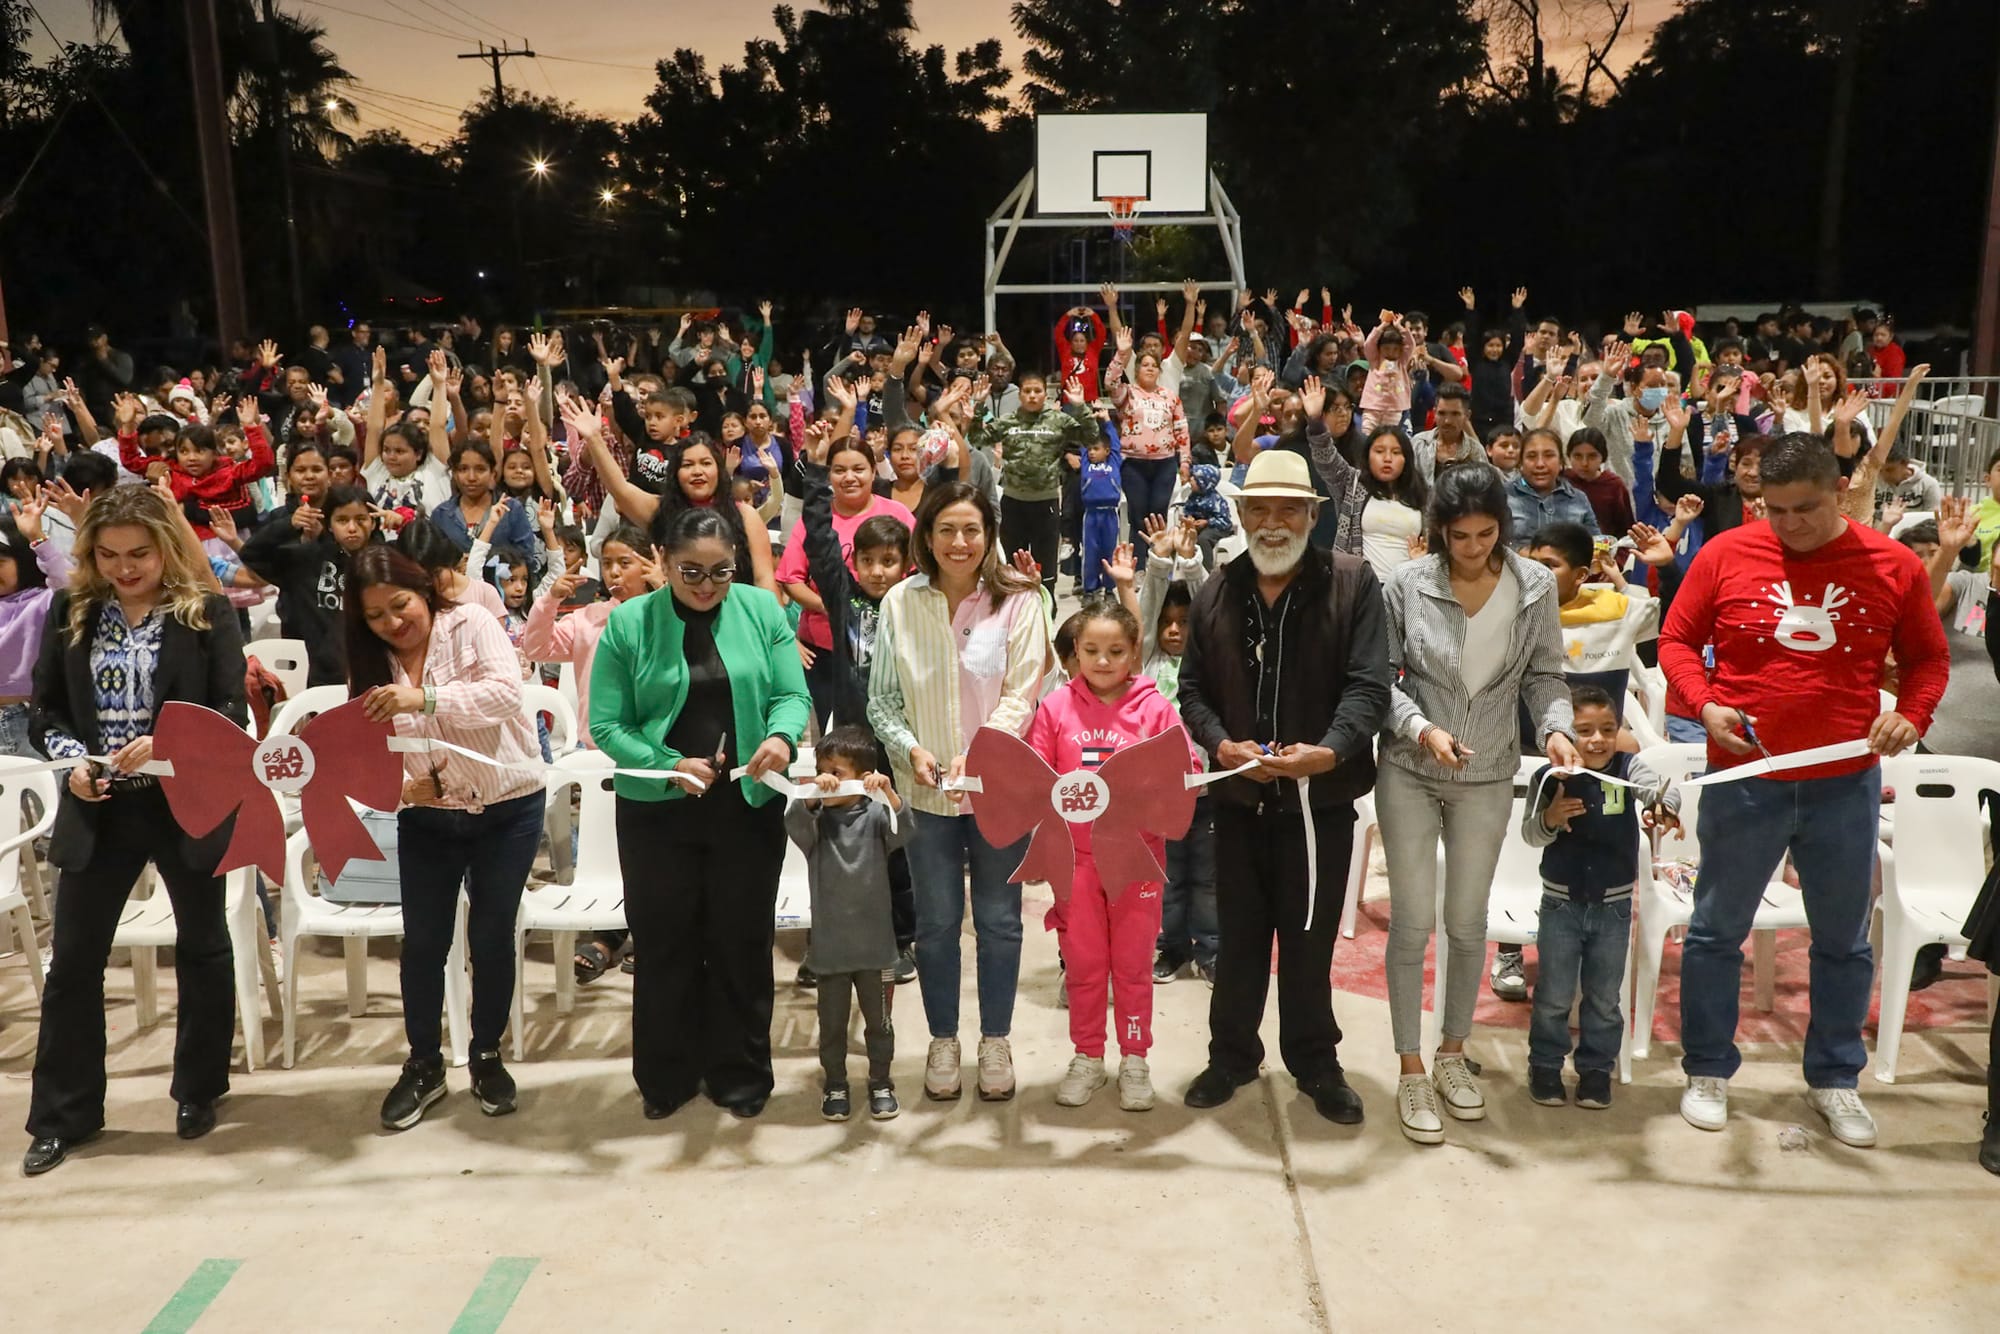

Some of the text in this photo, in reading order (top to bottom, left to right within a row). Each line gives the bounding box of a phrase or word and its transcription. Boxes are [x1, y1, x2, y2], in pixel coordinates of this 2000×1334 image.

[1071, 728, 1128, 748] TOMMY
[265, 762, 304, 781] PAZ
[1061, 796, 1099, 812] PAZ
